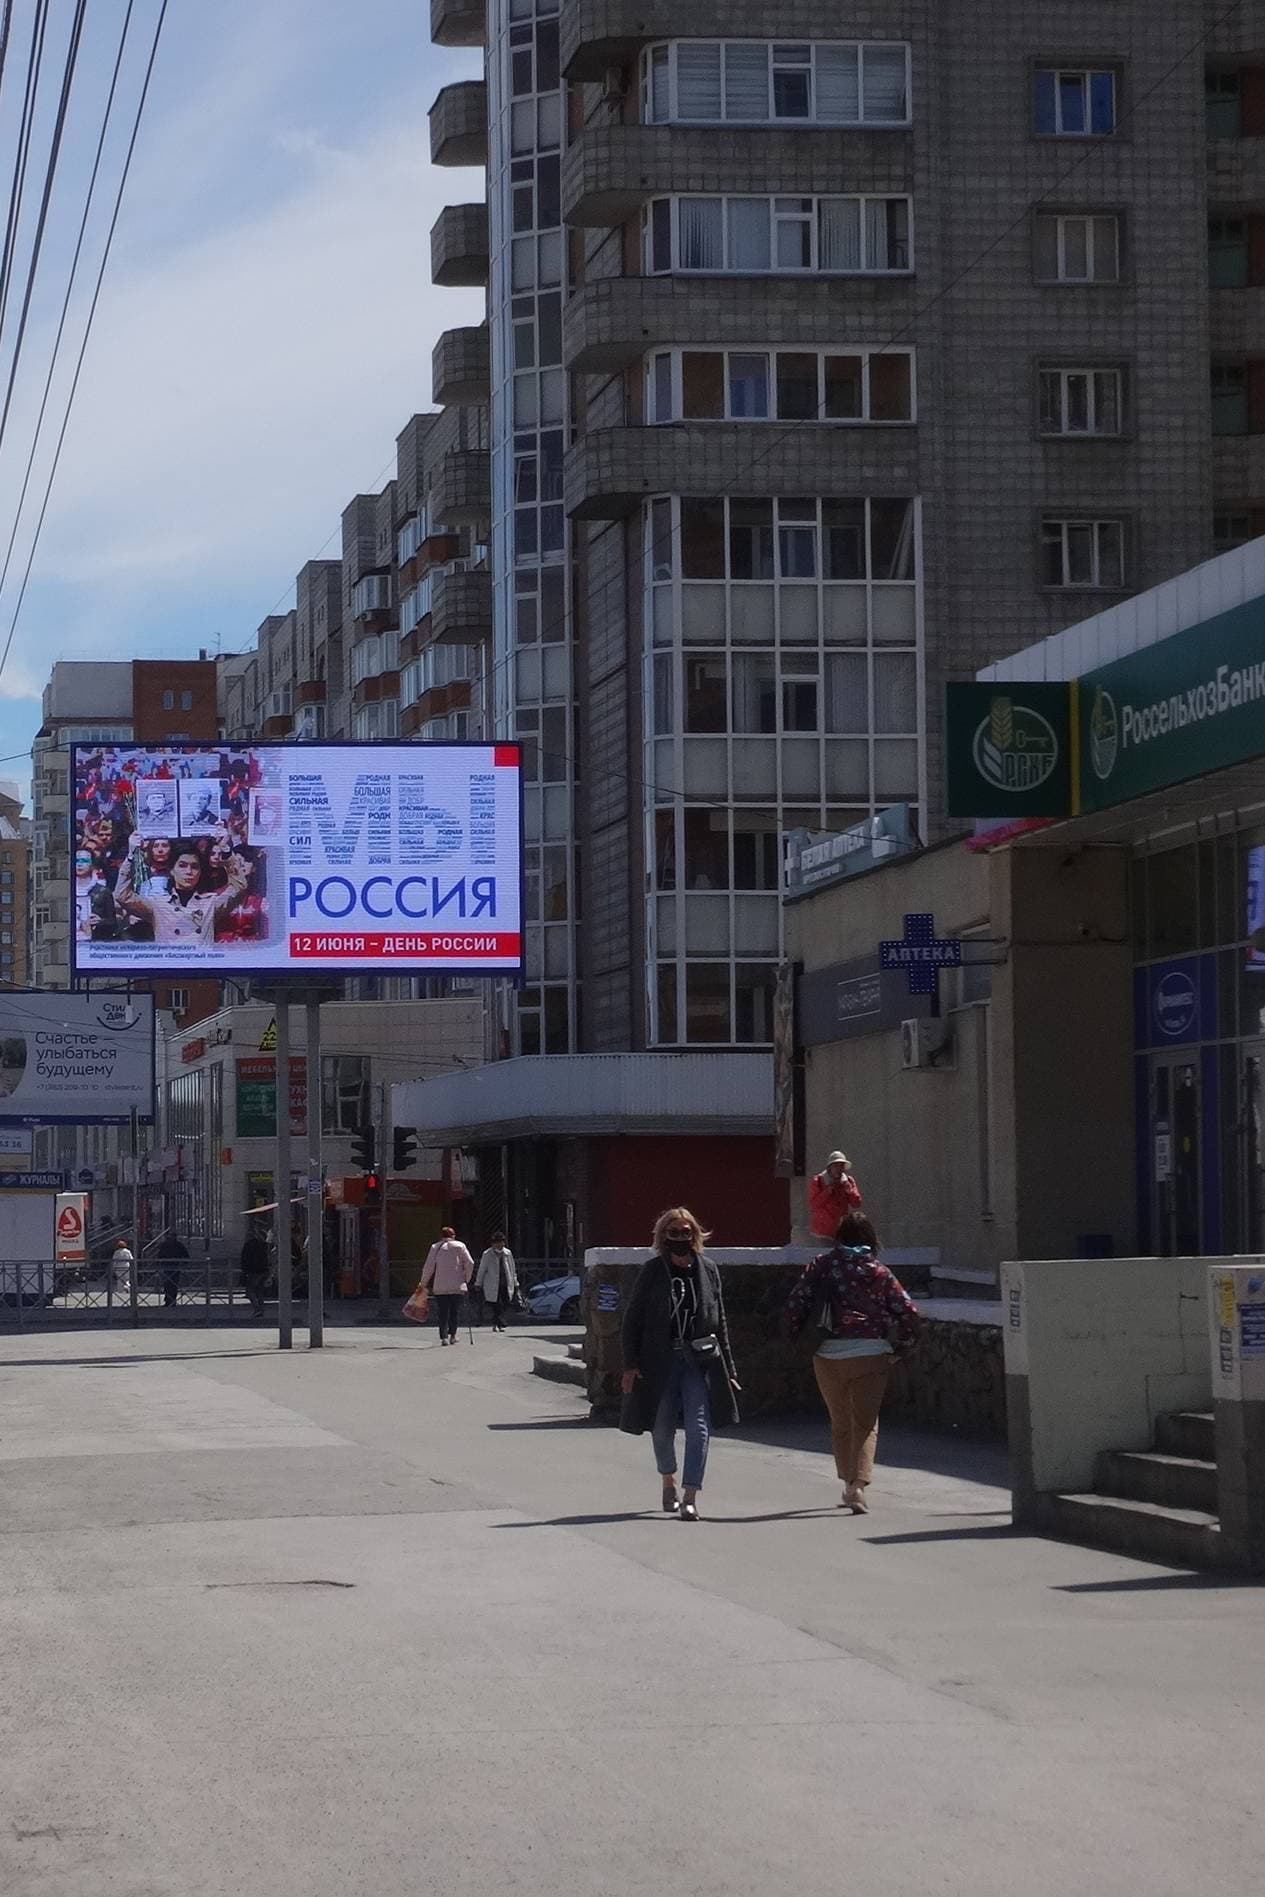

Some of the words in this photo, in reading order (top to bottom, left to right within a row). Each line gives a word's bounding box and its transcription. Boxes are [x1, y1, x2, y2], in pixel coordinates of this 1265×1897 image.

[288, 797, 329, 805] СИЛЬНАЯ
[289, 836, 311, 845] СИЛ
[289, 876, 496, 918] РОССИЯ
[294, 938, 312, 951] 12
[316, 937, 365, 951] ИЮНЯ
[382, 937, 427, 953] ДЕНЬ
[432, 937, 497, 951] РОССИИ
[887, 947, 956, 962] АПТЕКА
[36, 1031, 98, 1044] Счастье
[36, 1046, 117, 1061] улыбаться
[36, 1061, 114, 1078] будущему
[20, 1174, 60, 1185] ЖУРНАЛЫ
